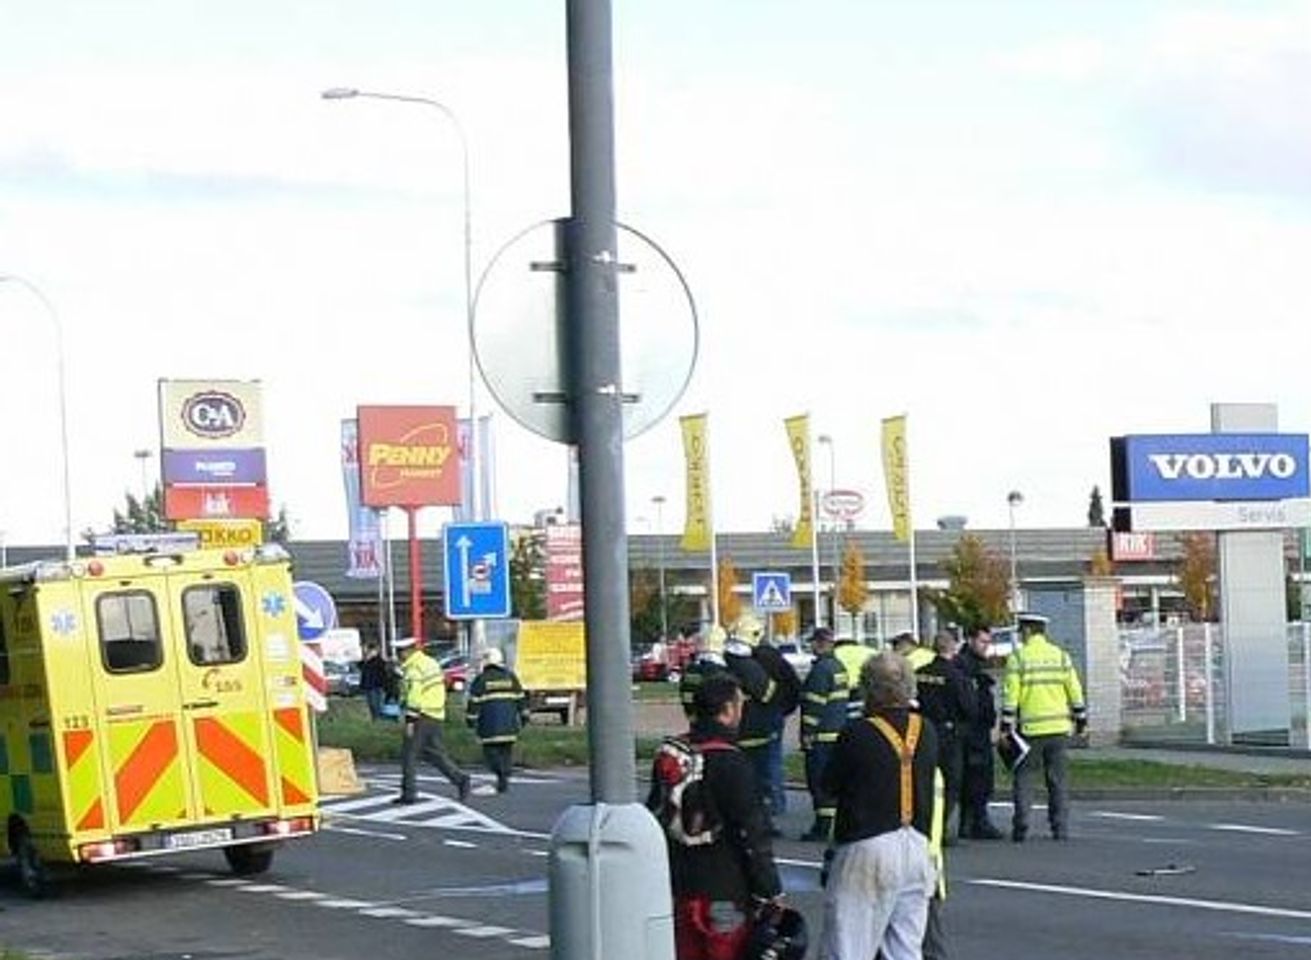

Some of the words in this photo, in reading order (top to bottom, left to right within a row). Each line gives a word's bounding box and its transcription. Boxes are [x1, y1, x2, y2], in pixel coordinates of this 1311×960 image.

[191, 402, 234, 427] C&A
[368, 444, 452, 466] PENNY
[1148, 453, 1297, 480] VOLVO
[1238, 506, 1286, 523] Servis
